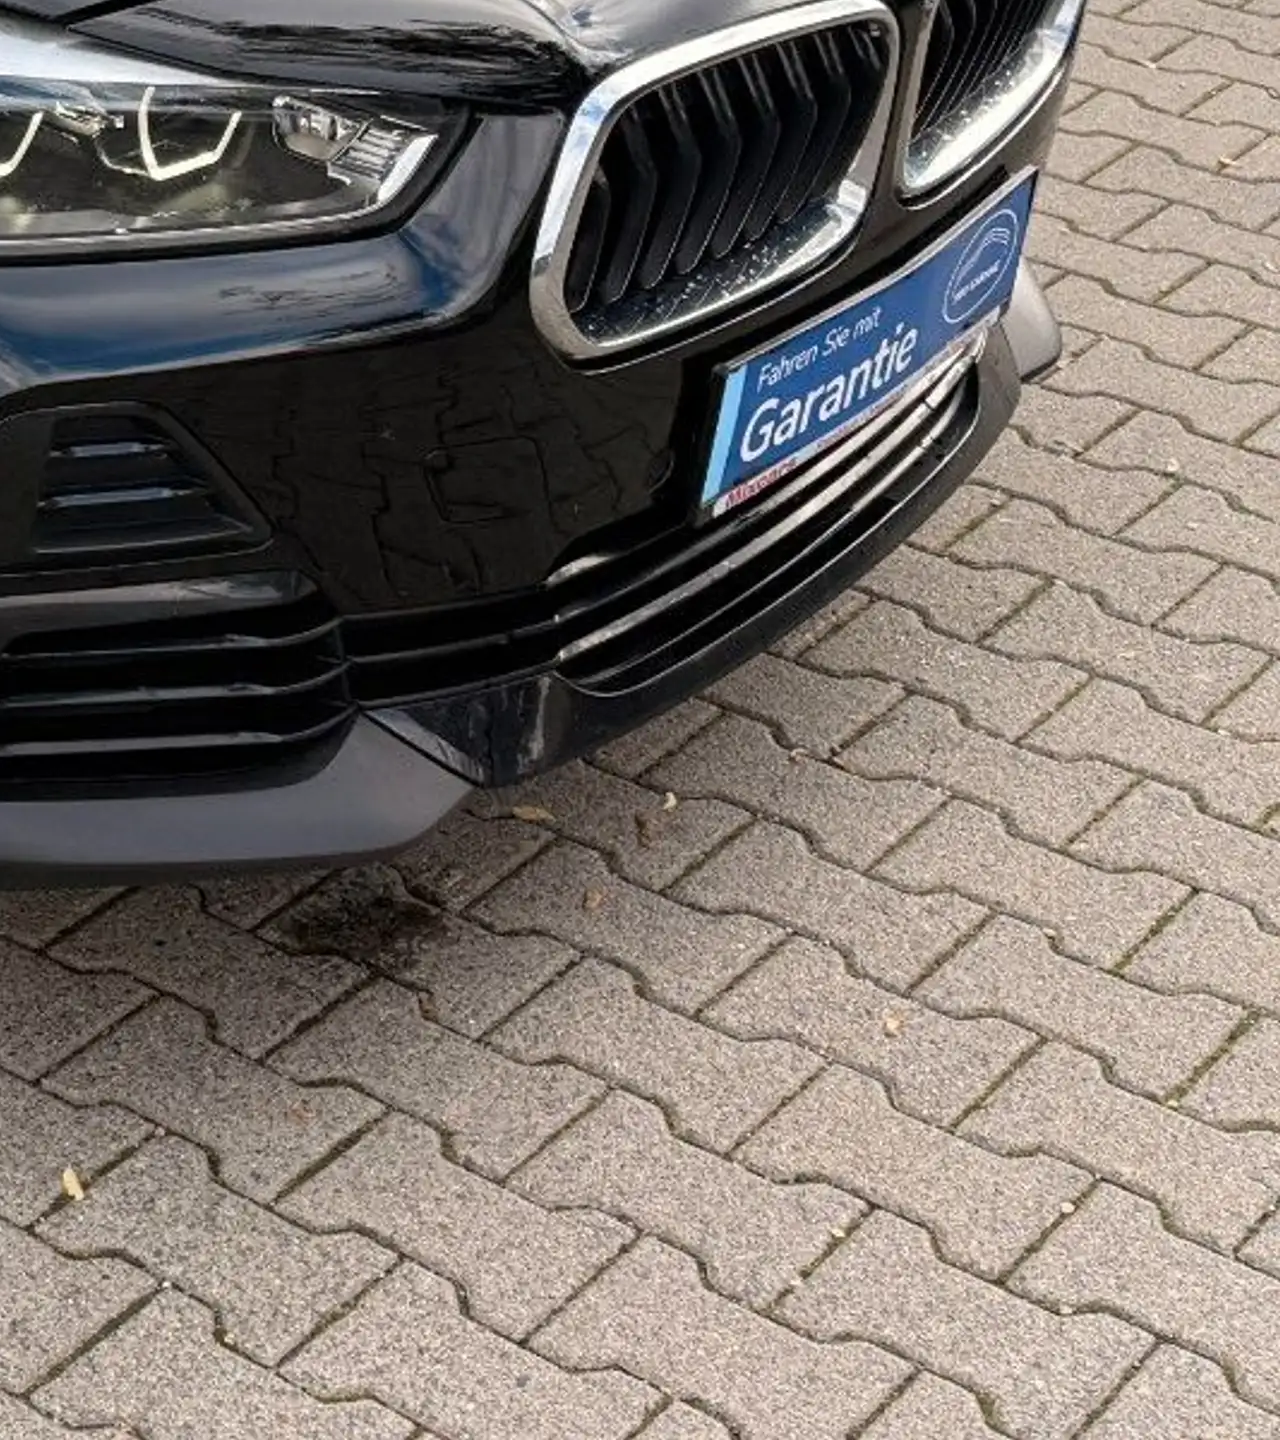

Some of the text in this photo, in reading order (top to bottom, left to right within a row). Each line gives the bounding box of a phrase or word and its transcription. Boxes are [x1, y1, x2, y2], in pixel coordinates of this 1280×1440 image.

[740, 321, 919, 462] Garantie
[757, 306, 882, 393] Fahren Sie mit
